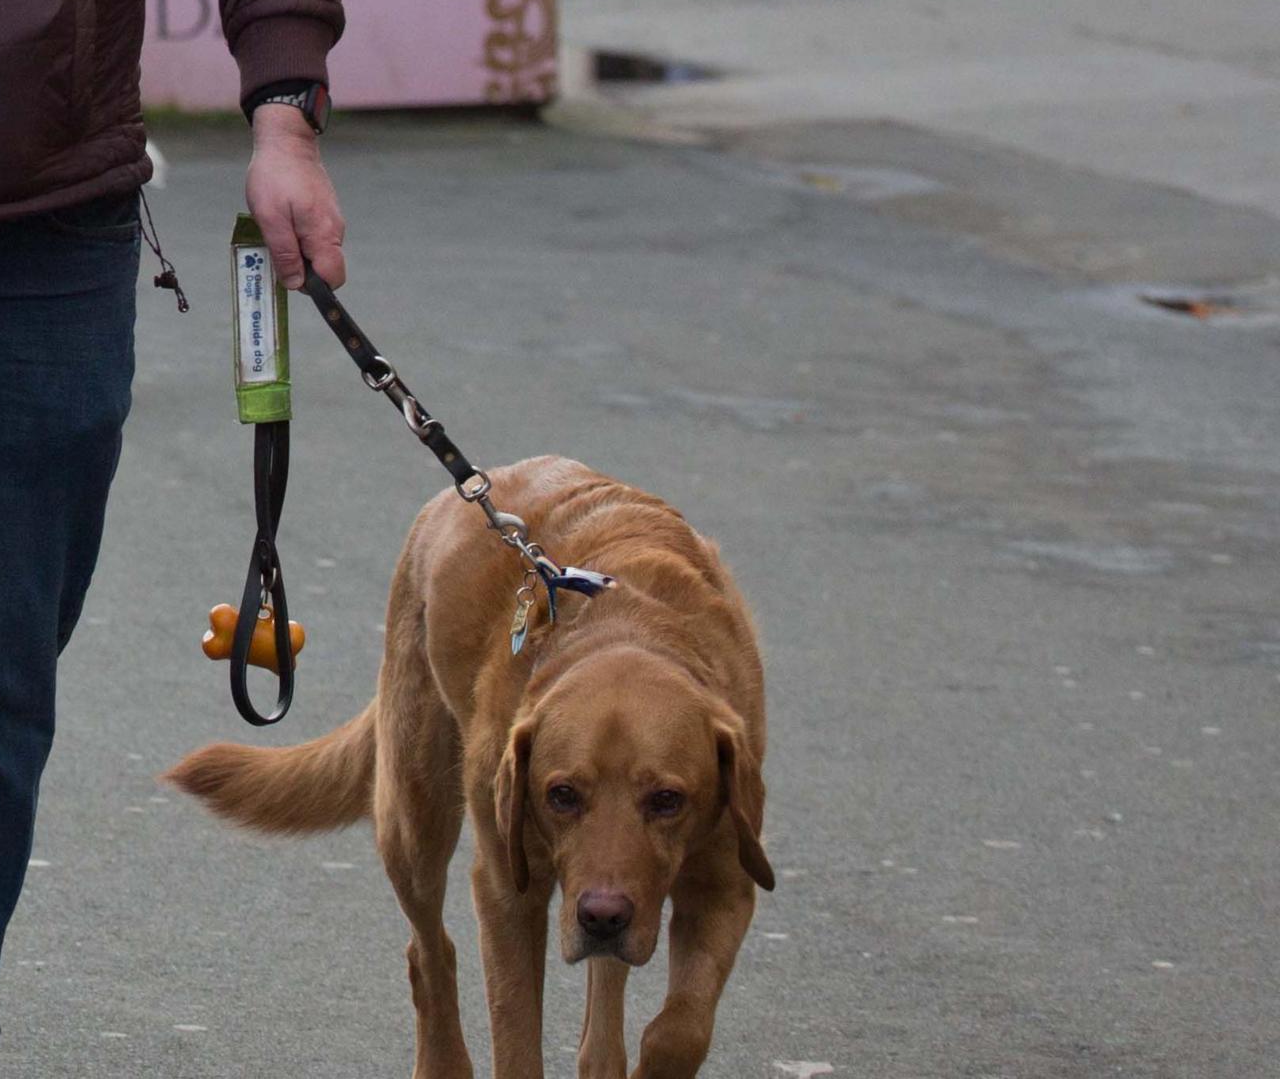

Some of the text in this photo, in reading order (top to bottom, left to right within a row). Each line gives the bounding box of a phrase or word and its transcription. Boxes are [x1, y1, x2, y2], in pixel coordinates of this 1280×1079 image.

[254, 274, 263, 300] Guide
[251, 311, 264, 373] Guide dog
